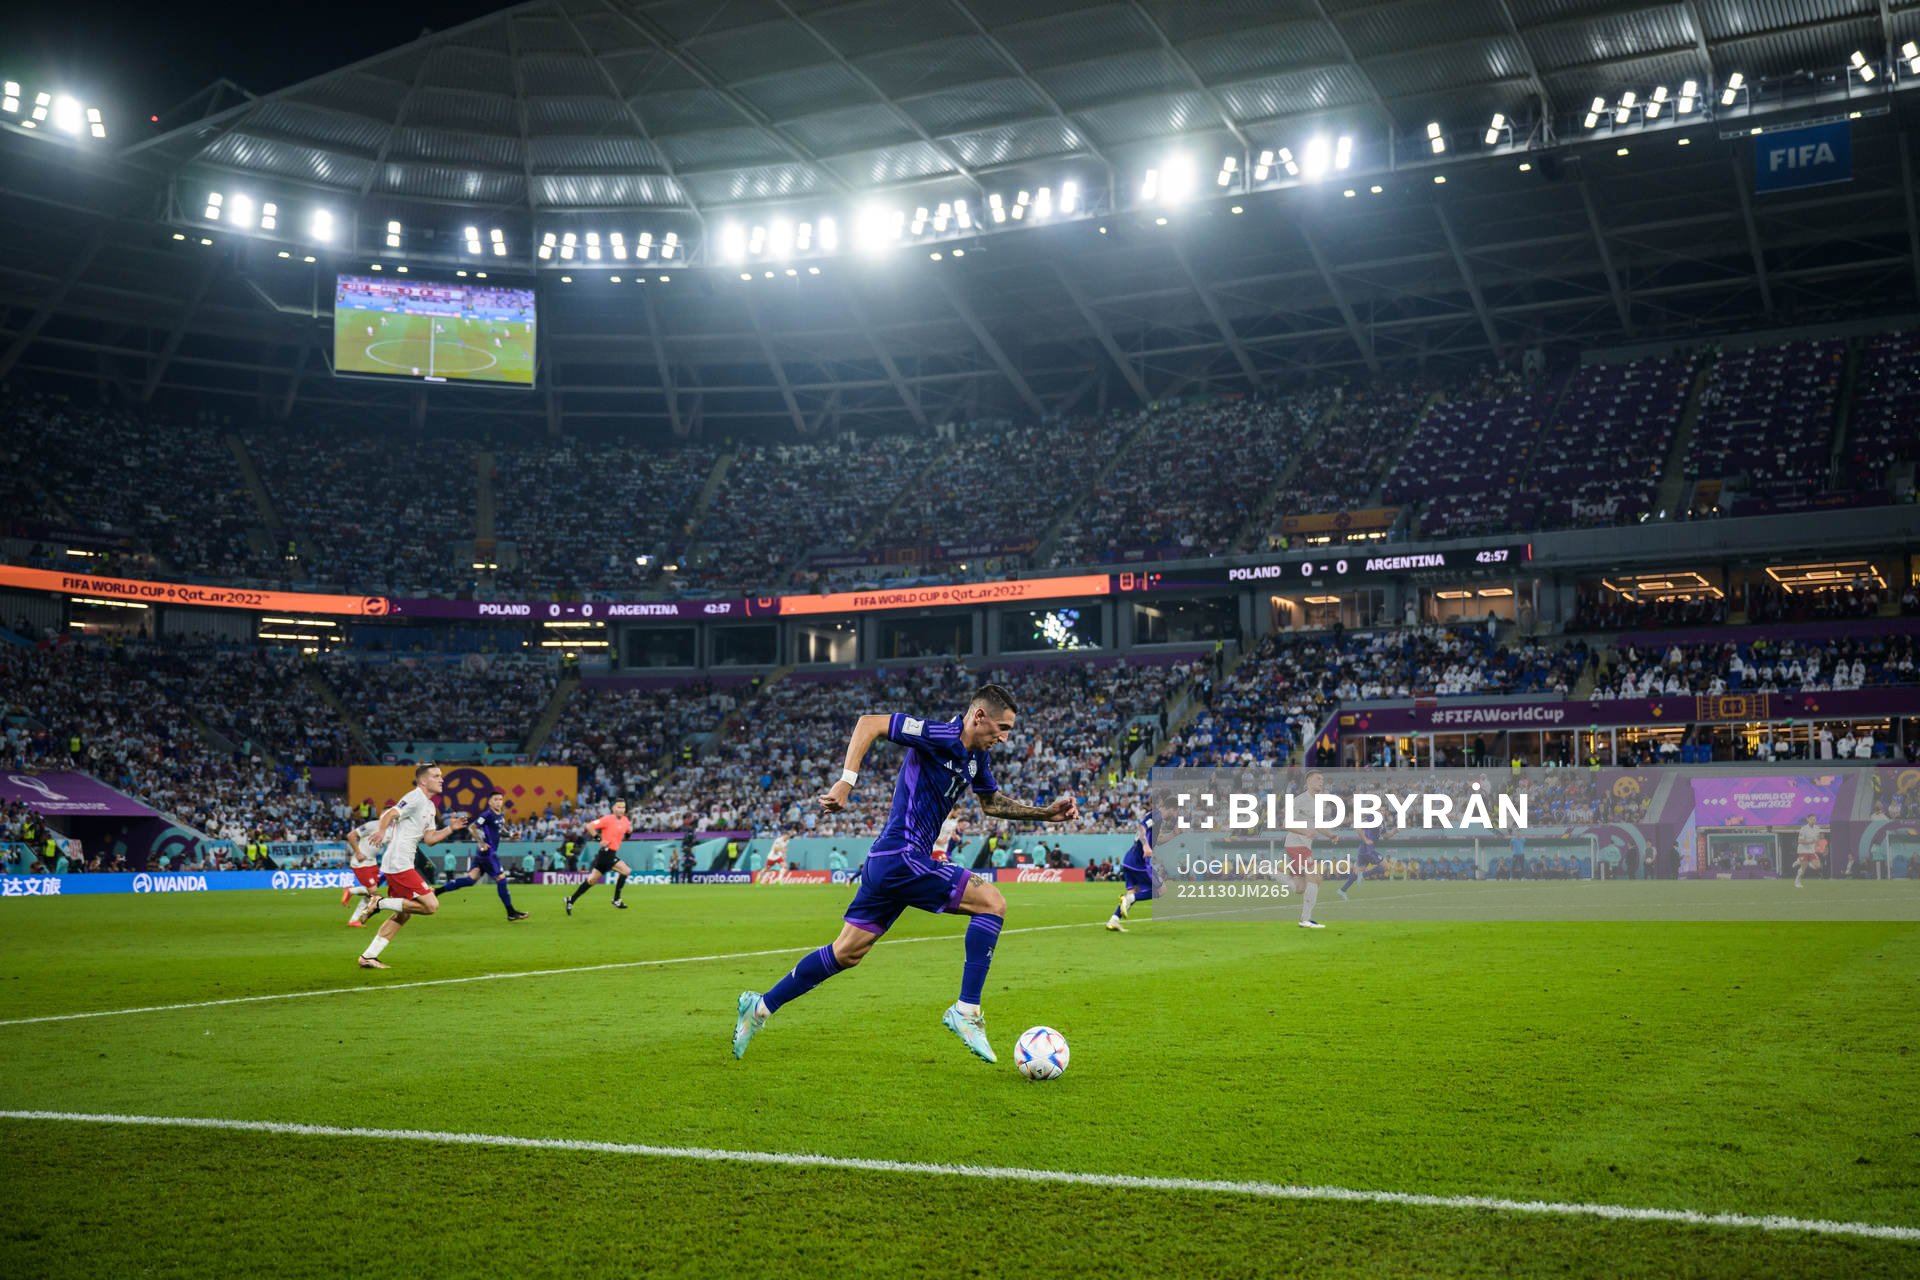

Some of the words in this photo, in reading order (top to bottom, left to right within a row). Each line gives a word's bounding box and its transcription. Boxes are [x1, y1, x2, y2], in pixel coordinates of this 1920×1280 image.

[1769, 142, 1836, 171] FIFA
[1229, 565, 1281, 580] POLAND
[1301, 563, 1313, 576] 0
[1336, 560, 1348, 574] 0
[1365, 553, 1445, 571] ARGENTINA
[1476, 550, 1509, 562] 42:57
[62, 577, 89, 590] FIFA
[91, 580, 138, 595] WORLD
[140, 584, 165, 597] CUP
[853, 595, 877, 607] FIFA
[878, 593, 917, 605] WORLD
[919, 591, 940, 602] CUP
[478, 604, 530, 615] POLAND
[549, 605, 560, 616] 0
[582, 604, 593, 616] 0
[608, 604, 678, 616] ARGENTINA
[703, 603, 731, 614] 42:57
[1431, 706, 1564, 723] #FIFAWorldCup
[1734, 793, 1751, 801] FIFA
[1780, 792, 1796, 800] CUP
[0, 877, 61, 896] 达文旅
[154, 875, 208, 892] WANDA
[605, 872, 672, 885] Hsense
[692, 872, 750, 884] crypto.com
